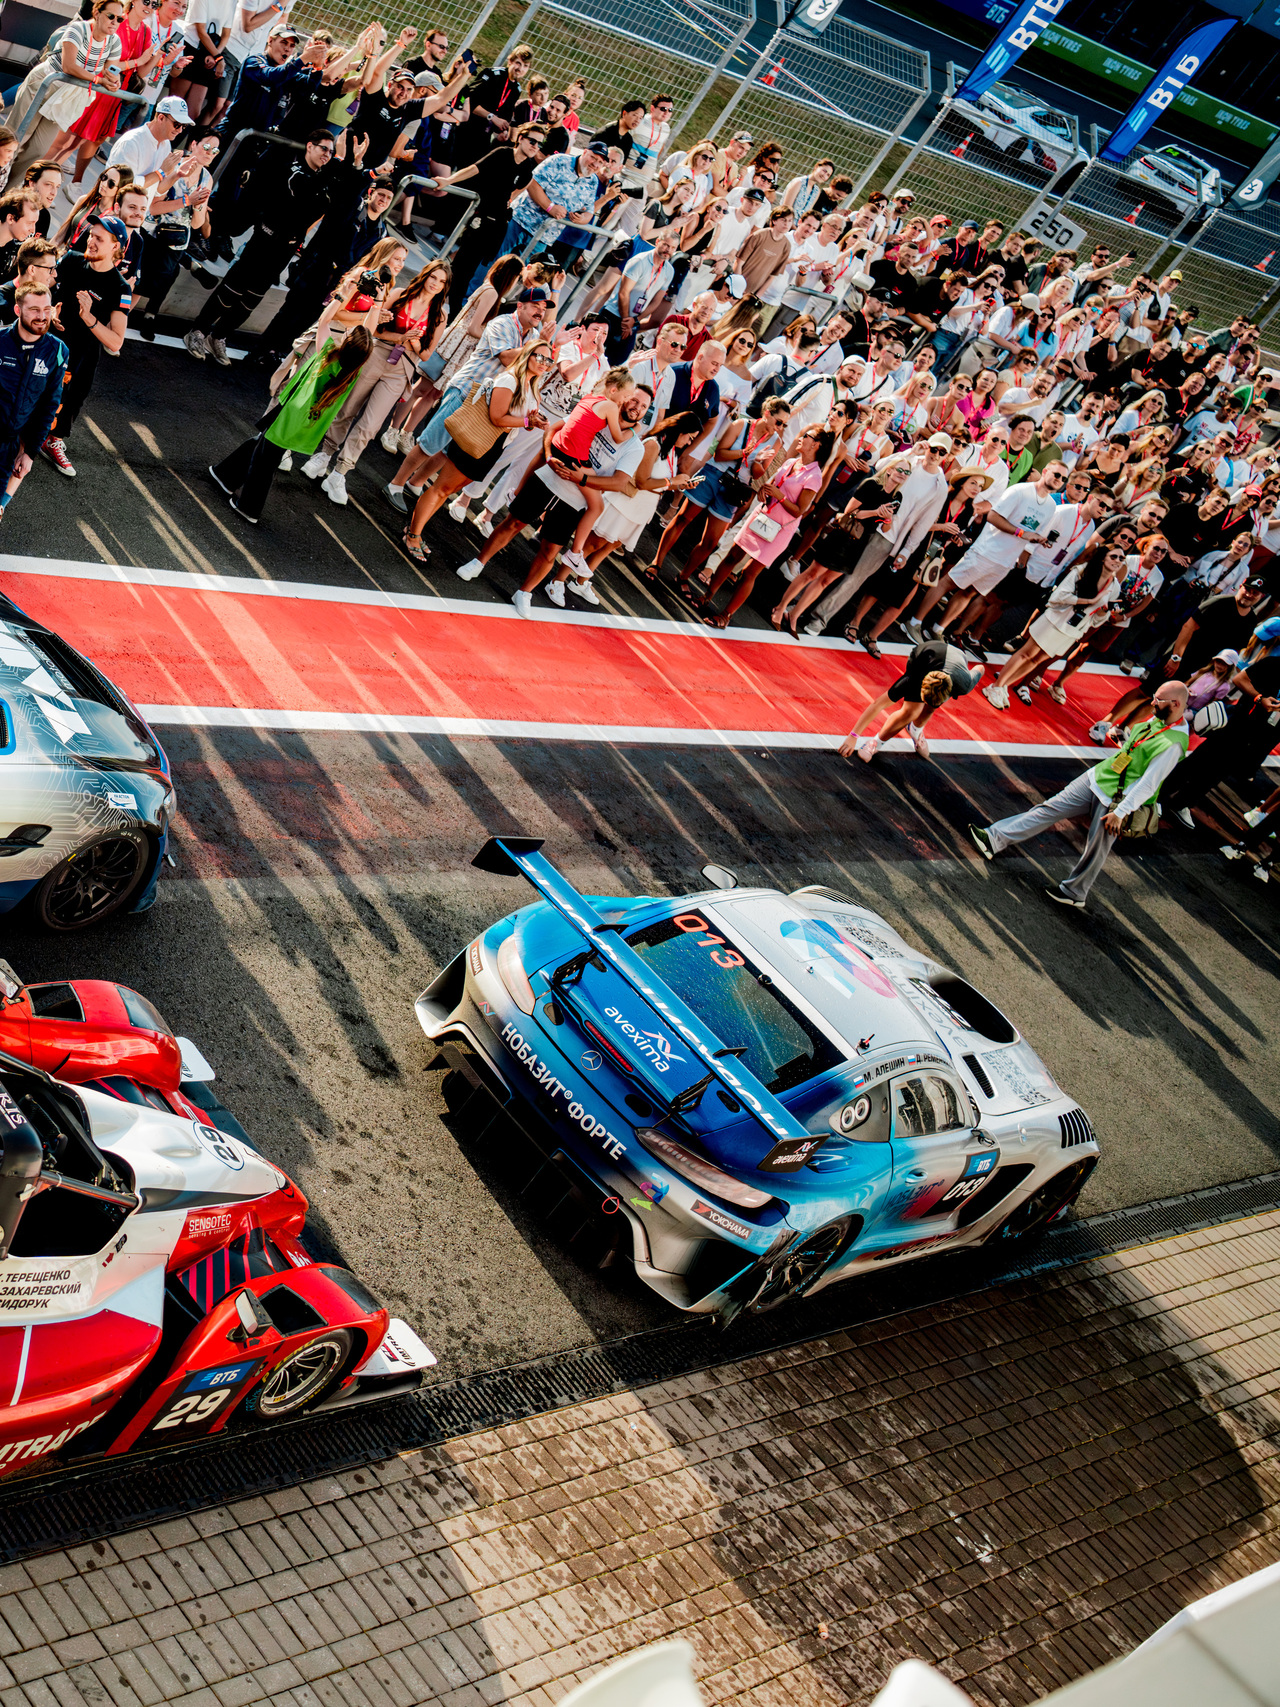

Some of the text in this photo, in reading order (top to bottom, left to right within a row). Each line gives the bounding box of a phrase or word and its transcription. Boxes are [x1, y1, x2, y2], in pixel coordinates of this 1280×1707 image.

[985, 4, 1011, 24] ВТБ
[1147, 54, 1200, 110] ВТБ
[1030, 211, 1073, 246] 250
[673, 914, 746, 969] 013
[604, 1005, 671, 1074] avexima
[875, 1057, 906, 1075] АЛЕШИН
[567, 1097, 628, 1161] ФОРТЕ
[199, 1126, 241, 1162] 29
[772, 1153, 807, 1165] avexima
[976, 1158, 992, 1172] ВТБ
[942, 1176, 986, 1201] 013
[189, 1214, 232, 1232] SENSOTEC
[708, 1210, 750, 1239] YOKOHAMA
[209, 1368, 241, 1386] ВТБ
[152, 1388, 231, 1431] 29
